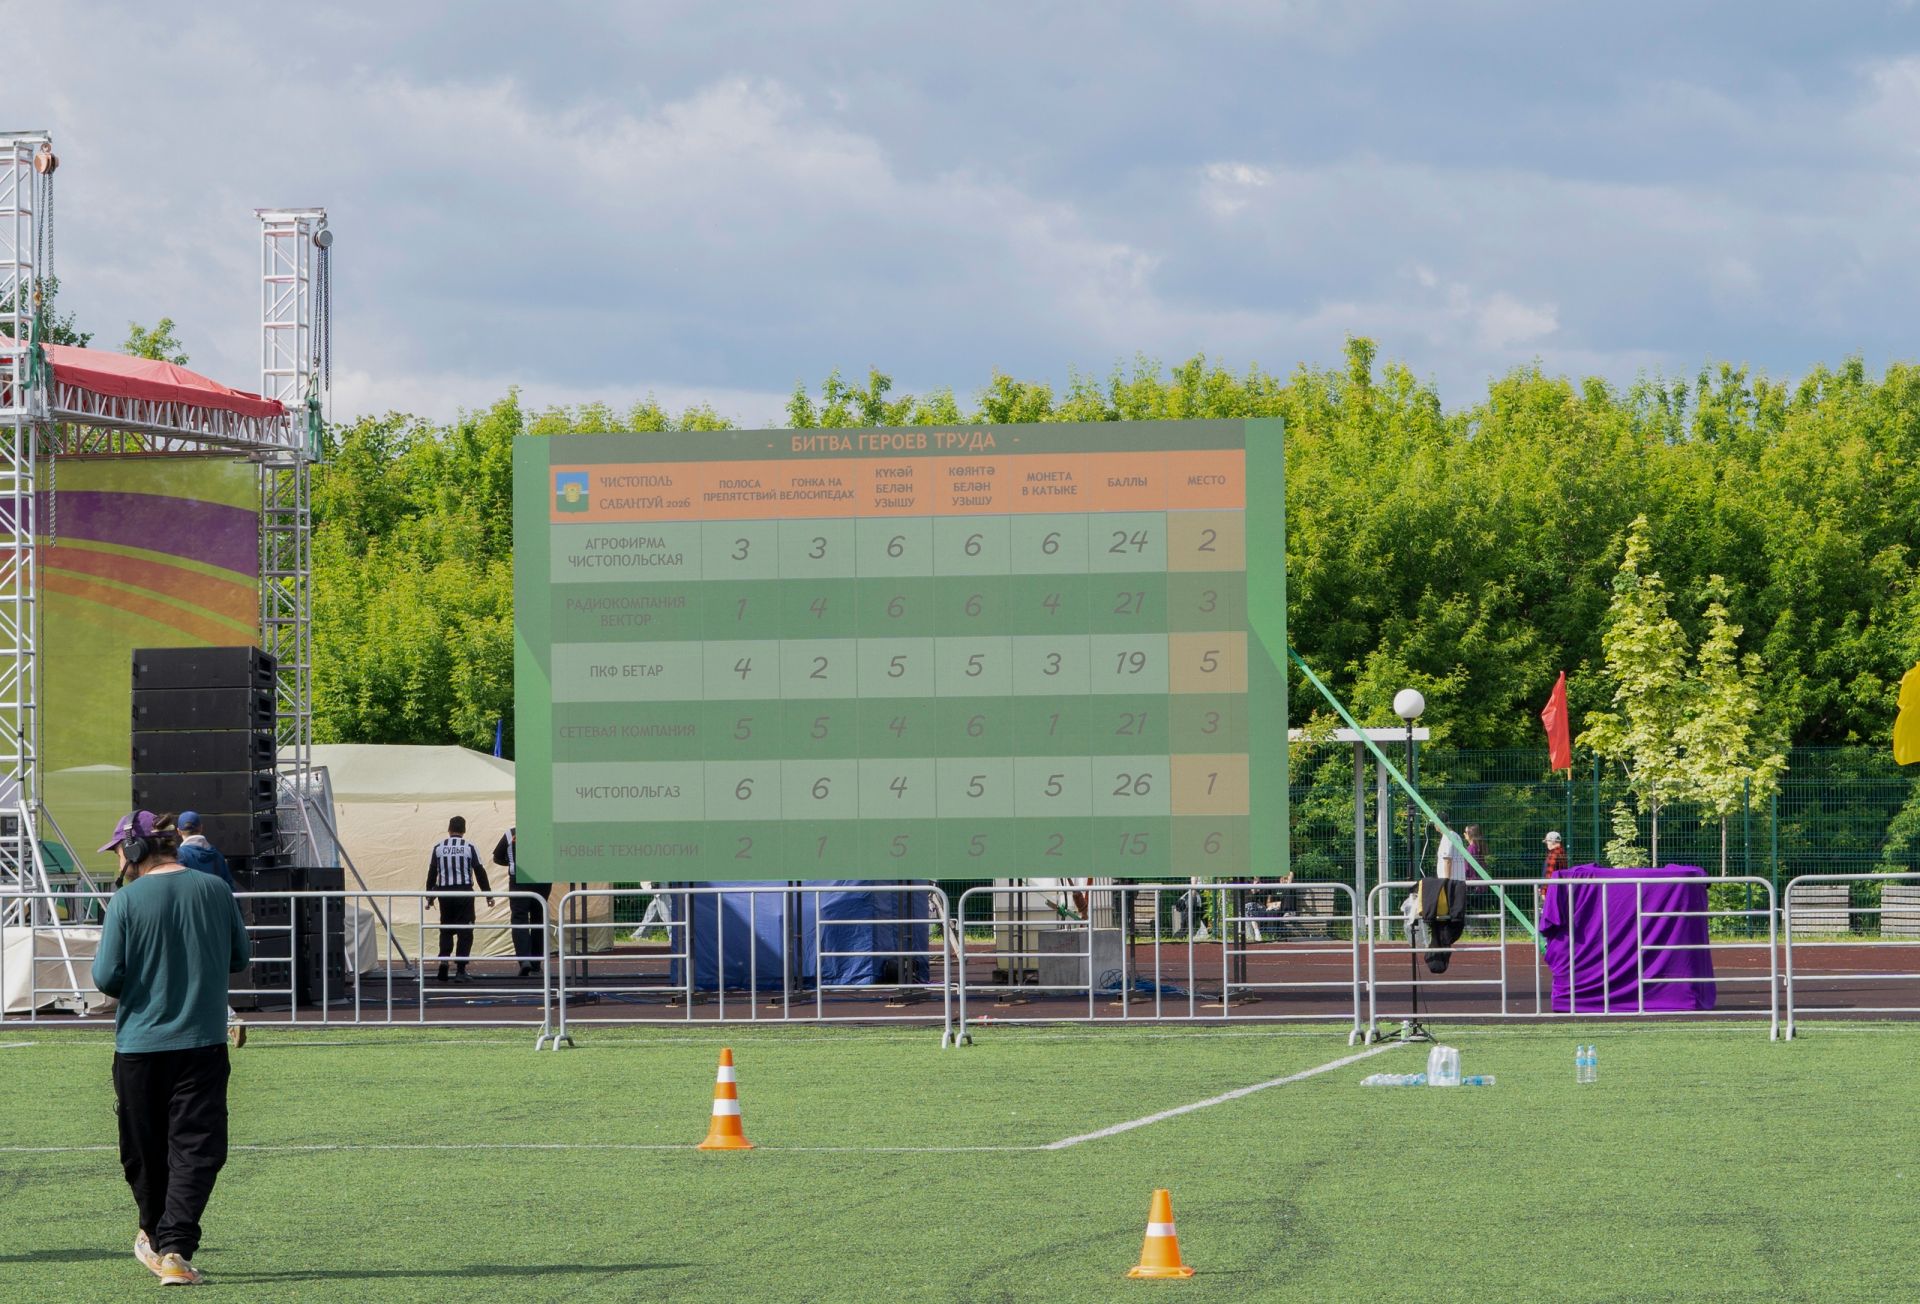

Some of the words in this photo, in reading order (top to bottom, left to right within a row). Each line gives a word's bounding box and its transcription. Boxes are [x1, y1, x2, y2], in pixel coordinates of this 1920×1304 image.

[791, 435, 851, 451] БИТВА
[858, 434, 927, 451] ГЕРОЕВ
[934, 432, 996, 451] ТРУДА
[600, 475, 673, 488] ЧИСТОПОЛЬ
[791, 478, 825, 488] ГОНКА
[828, 477, 842, 487] НА
[948, 466, 996, 476] КӨЯНТӘ
[1026, 471, 1073, 482] МОНЕТА
[1107, 477, 1148, 488] БАЛЛЫ
[1187, 475, 1226, 486] МЕСТО
[703, 489, 777, 502] ПРЕПЯТСТВИЙ
[719, 479, 761, 489] ПОЛОСА
[780, 490, 855, 501] ВЕЛОСИПЕДАХ
[876, 484, 913, 493] БЕЛӘН
[953, 482, 991, 492] БЕЛӘН
[1022, 486, 1029, 496] В
[1032, 485, 1078, 496] КАТЫКЕ
[600, 496, 664, 510] САБАНТУЙ
[666, 497, 691, 508] 2026
[874, 498, 915, 508] УЗЫШУ
[952, 496, 992, 506] УЗЫШУ
[585, 538, 666, 550] АГРОФИРМА
[731, 538, 751, 561] 3
[808, 536, 828, 559] 3
[887, 535, 906, 558] 6
[964, 534, 984, 556] 6
[1042, 532, 1062, 554] 6
[1109, 530, 1149, 553] 24
[1198, 529, 1217, 552] 2
[568, 553, 684, 567] ЧИСТОПОЛЬСКАЯ
[566, 596, 686, 613] РАДИОКОМПАНИЯ
[737, 598, 747, 620] 1
[809, 597, 828, 619] 4
[887, 596, 906, 618] 6
[965, 594, 984, 617] 6
[1043, 593, 1061, 616] 4
[1113, 591, 1145, 615] 21
[1199, 590, 1218, 613] 3
[600, 614, 652, 626] ВЕКТОР
[590, 666, 618, 678] ПКФ
[622, 665, 664, 677] БЕТАР
[734, 657, 752, 681] 4
[810, 656, 829, 680] 2
[887, 655, 907, 678] 5
[965, 654, 985, 677] 5
[1043, 652, 1062, 676] 3
[1116, 651, 1146, 674] 19
[1199, 650, 1220, 673] 5
[560, 725, 617, 738] СЕТЕВАЯ
[621, 725, 696, 738] КОМПАНИЯ
[733, 717, 753, 741] 5
[810, 716, 830, 740] 5
[889, 715, 907, 738] 4
[967, 714, 986, 737] 6
[1049, 713, 1060, 736] 1
[1115, 712, 1148, 735] 21
[1201, 711, 1220, 734] 3
[575, 785, 680, 799] ЧИСТОПОЛЬГАЗ
[735, 778, 754, 801] 6
[811, 777, 831, 800] 6
[889, 776, 908, 799] 4
[966, 775, 987, 798] 5
[1044, 774, 1064, 797] 5
[1112, 773, 1152, 796] 26
[1206, 772, 1218, 796] 1
[442, 846, 465, 855] СУДЬЯ
[559, 844, 605, 858] НОВЫЕ
[609, 843, 698, 857] ТЕХНОЛОГИИ
[734, 837, 753, 859] 2
[816, 836, 828, 859] 1
[889, 835, 909, 858] 5
[967, 834, 988, 857] 5
[1045, 833, 1064, 856] 2
[1117, 832, 1150, 856] 15
[1203, 831, 1222, 854] 6
